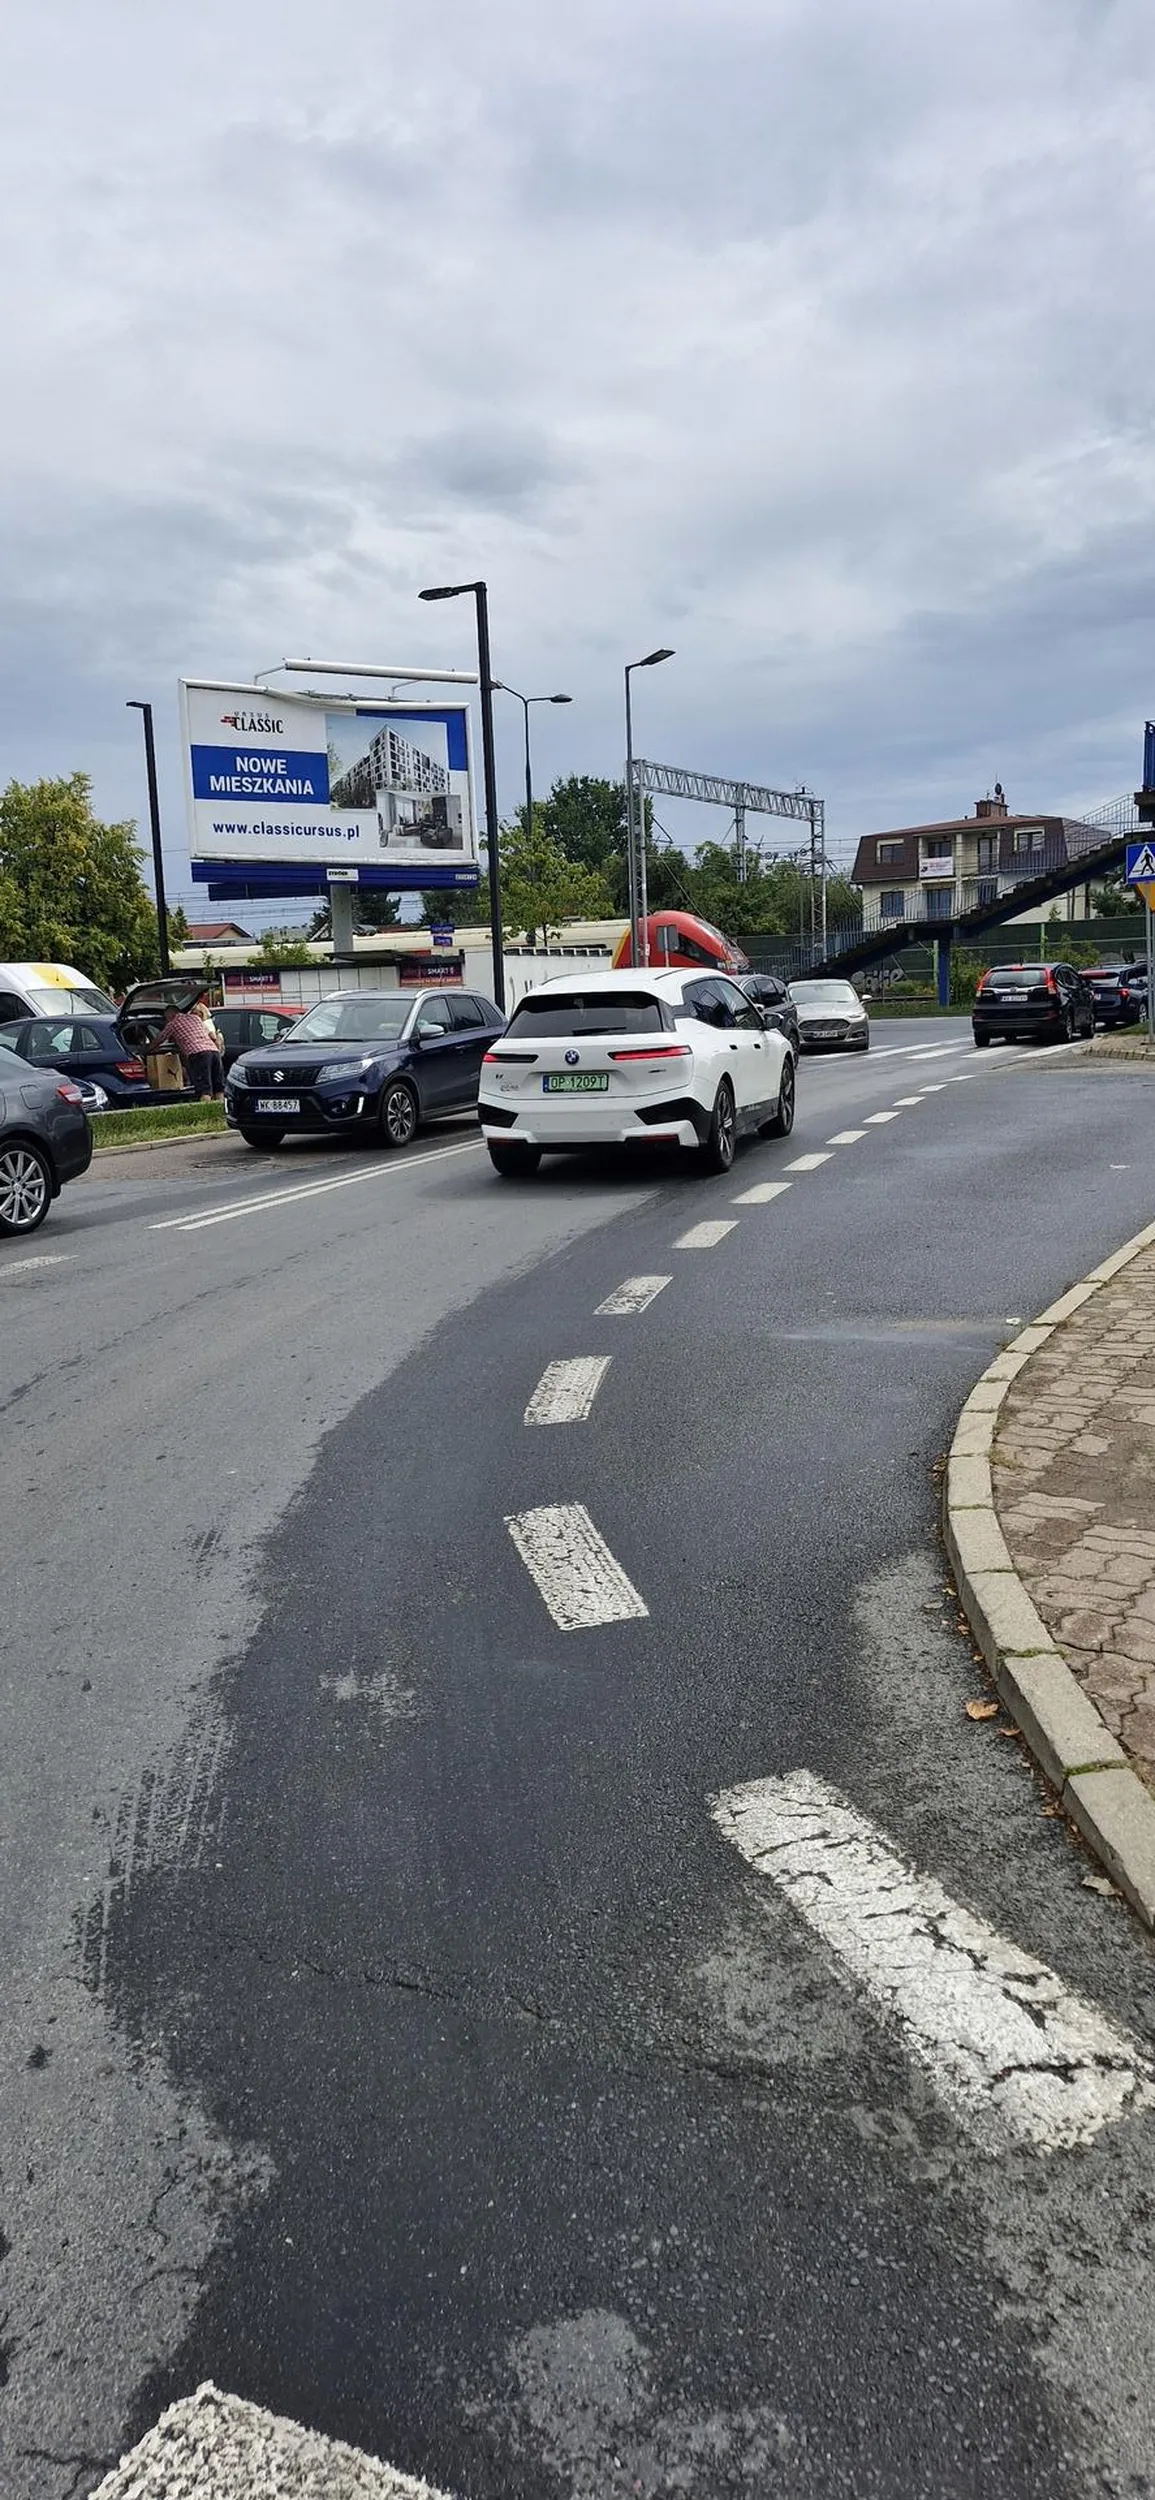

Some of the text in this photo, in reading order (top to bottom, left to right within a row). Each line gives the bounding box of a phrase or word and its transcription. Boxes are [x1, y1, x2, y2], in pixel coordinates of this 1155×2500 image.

[233, 716, 284, 734] CLASSIC
[236, 756, 288, 775] NOWE
[210, 775, 314, 796] MIESZKANIA
[213, 821, 360, 840] www.classicursus.pl
[551, 1075, 605, 1090] OP 1209T
